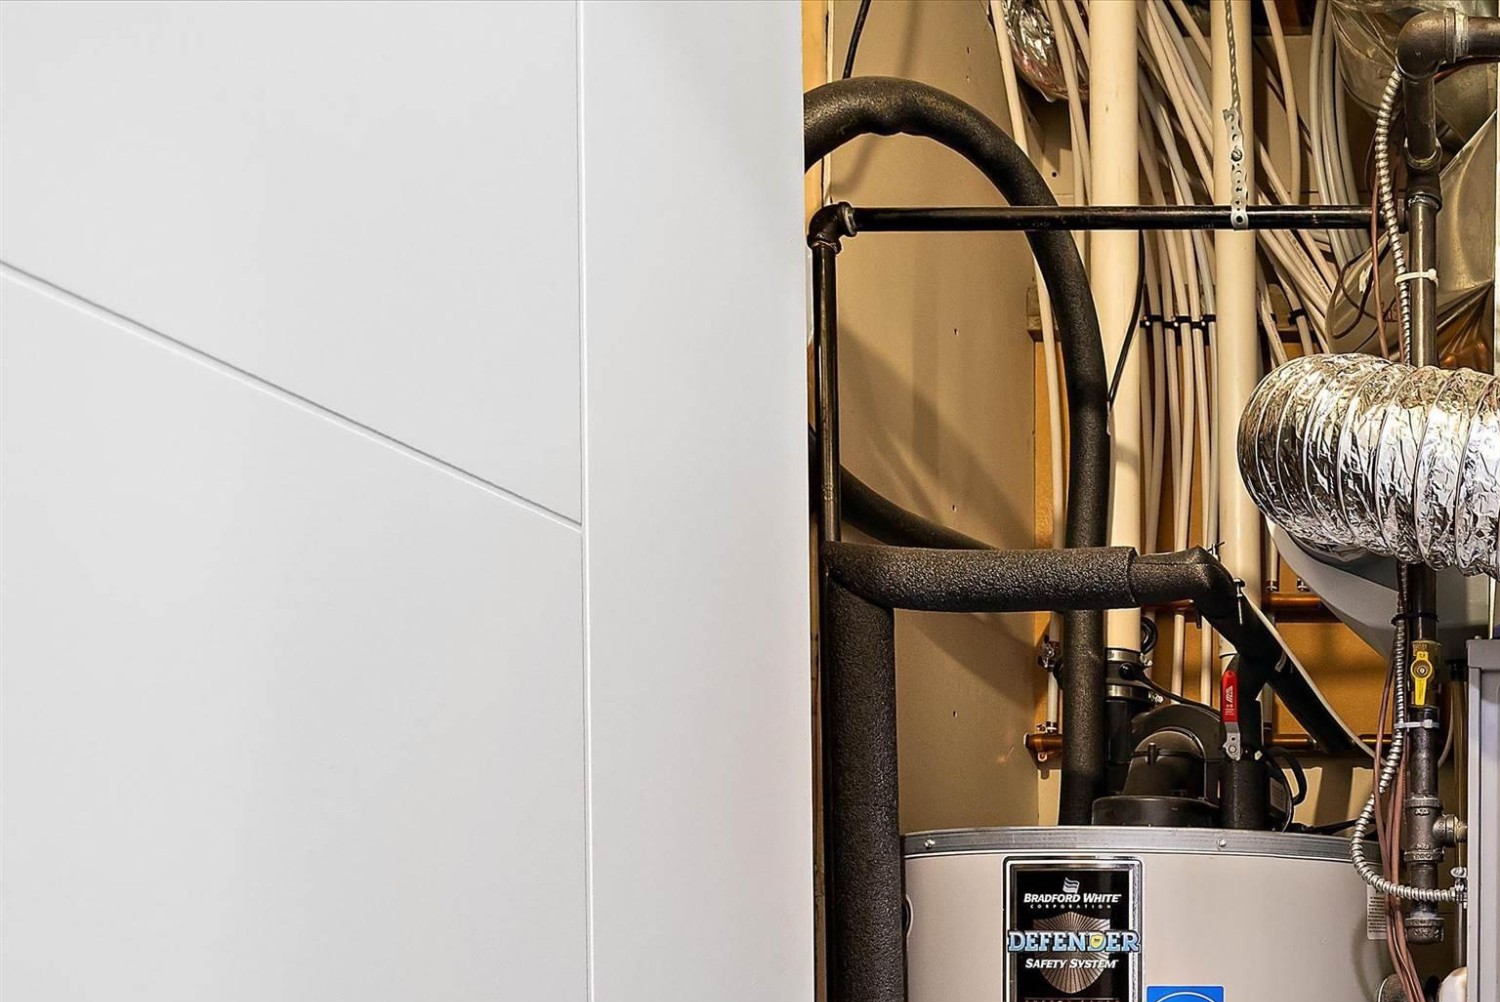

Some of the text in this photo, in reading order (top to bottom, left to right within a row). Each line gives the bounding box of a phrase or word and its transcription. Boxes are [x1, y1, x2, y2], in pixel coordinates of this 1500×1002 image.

[1024, 893, 1081, 903] BRADFORD
[1008, 931, 1141, 953] DEFENDER
[1025, 958, 1066, 969] SAFETY
